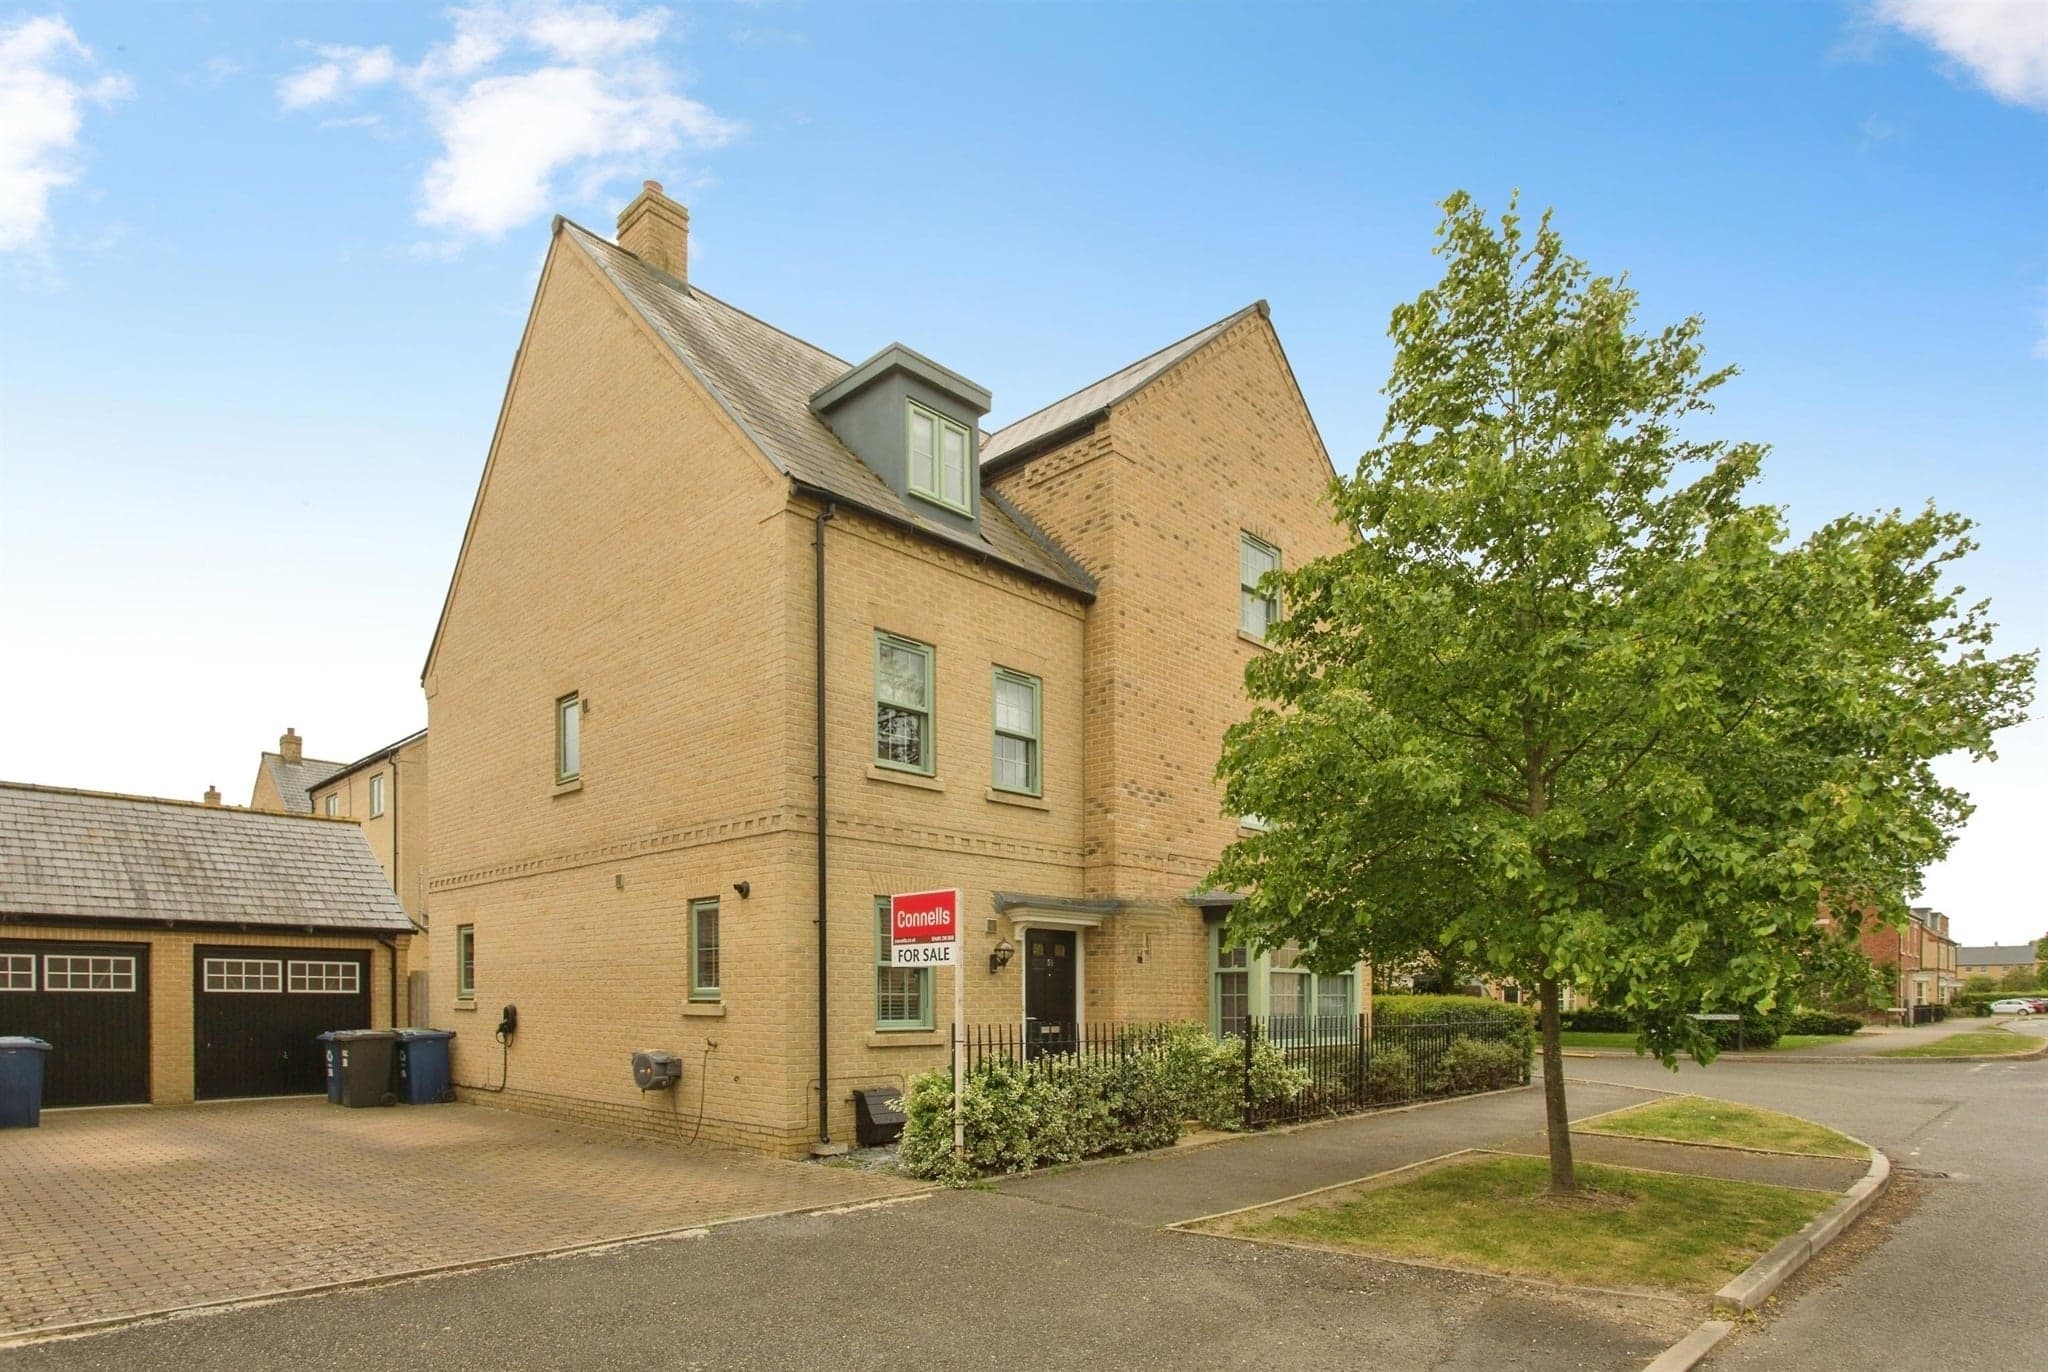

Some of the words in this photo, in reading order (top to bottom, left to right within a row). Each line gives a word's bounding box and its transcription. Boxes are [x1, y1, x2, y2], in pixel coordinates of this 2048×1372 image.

[897, 907, 950, 928] Connells
[898, 949, 920, 962] FOR
[923, 947, 950, 962] SALE
